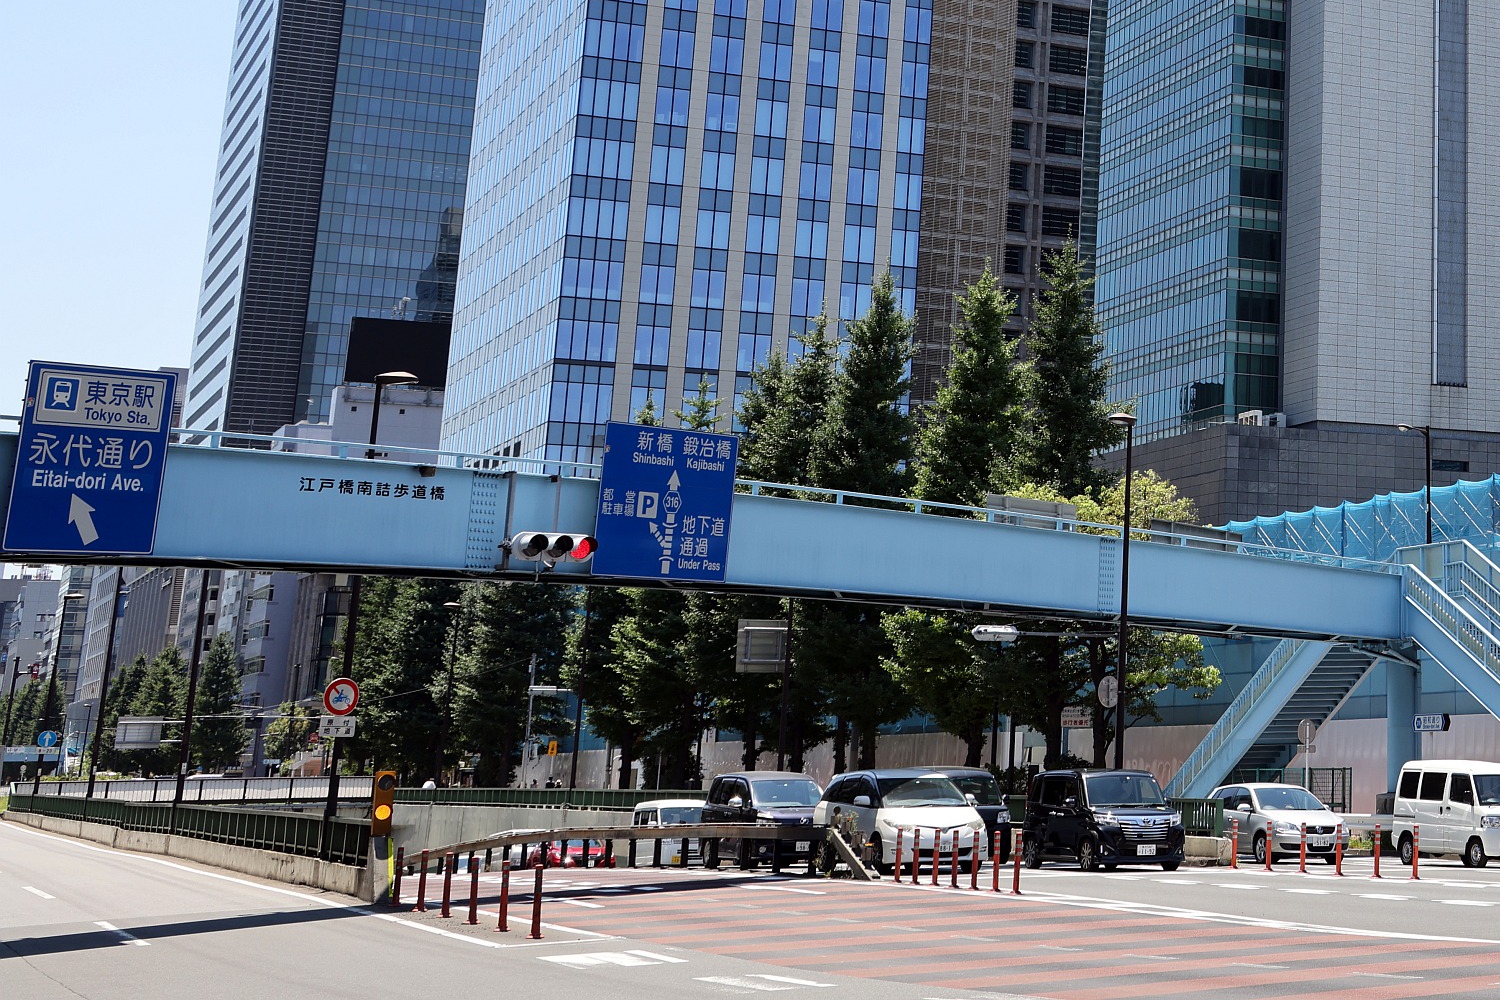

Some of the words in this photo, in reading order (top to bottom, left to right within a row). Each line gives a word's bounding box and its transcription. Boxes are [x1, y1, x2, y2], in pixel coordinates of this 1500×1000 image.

[84, 381, 155, 409] 東京駅
[84, 407, 122, 424] Tokyo
[127, 411, 151, 425] Sta.
[28, 432, 153, 470] 永代通り
[637, 431, 673, 453] 新橋
[682, 436, 732, 460] 鍛冶橋
[632, 452, 675, 467] Shinbashi
[686, 458, 725, 472] Kajibashi
[32, 470, 106, 490] Eitai-dori
[111, 474, 144, 492] Ave.
[299, 476, 446, 501] 江戸橋南詰歩道橋
[601, 502, 635, 517] 駐車場
[665, 497, 679, 508] 316
[681, 515, 726, 537] 地下道
[679, 538, 708, 558] 通過
[677, 558, 700, 570] Under
[702, 560, 721, 571] Pass
